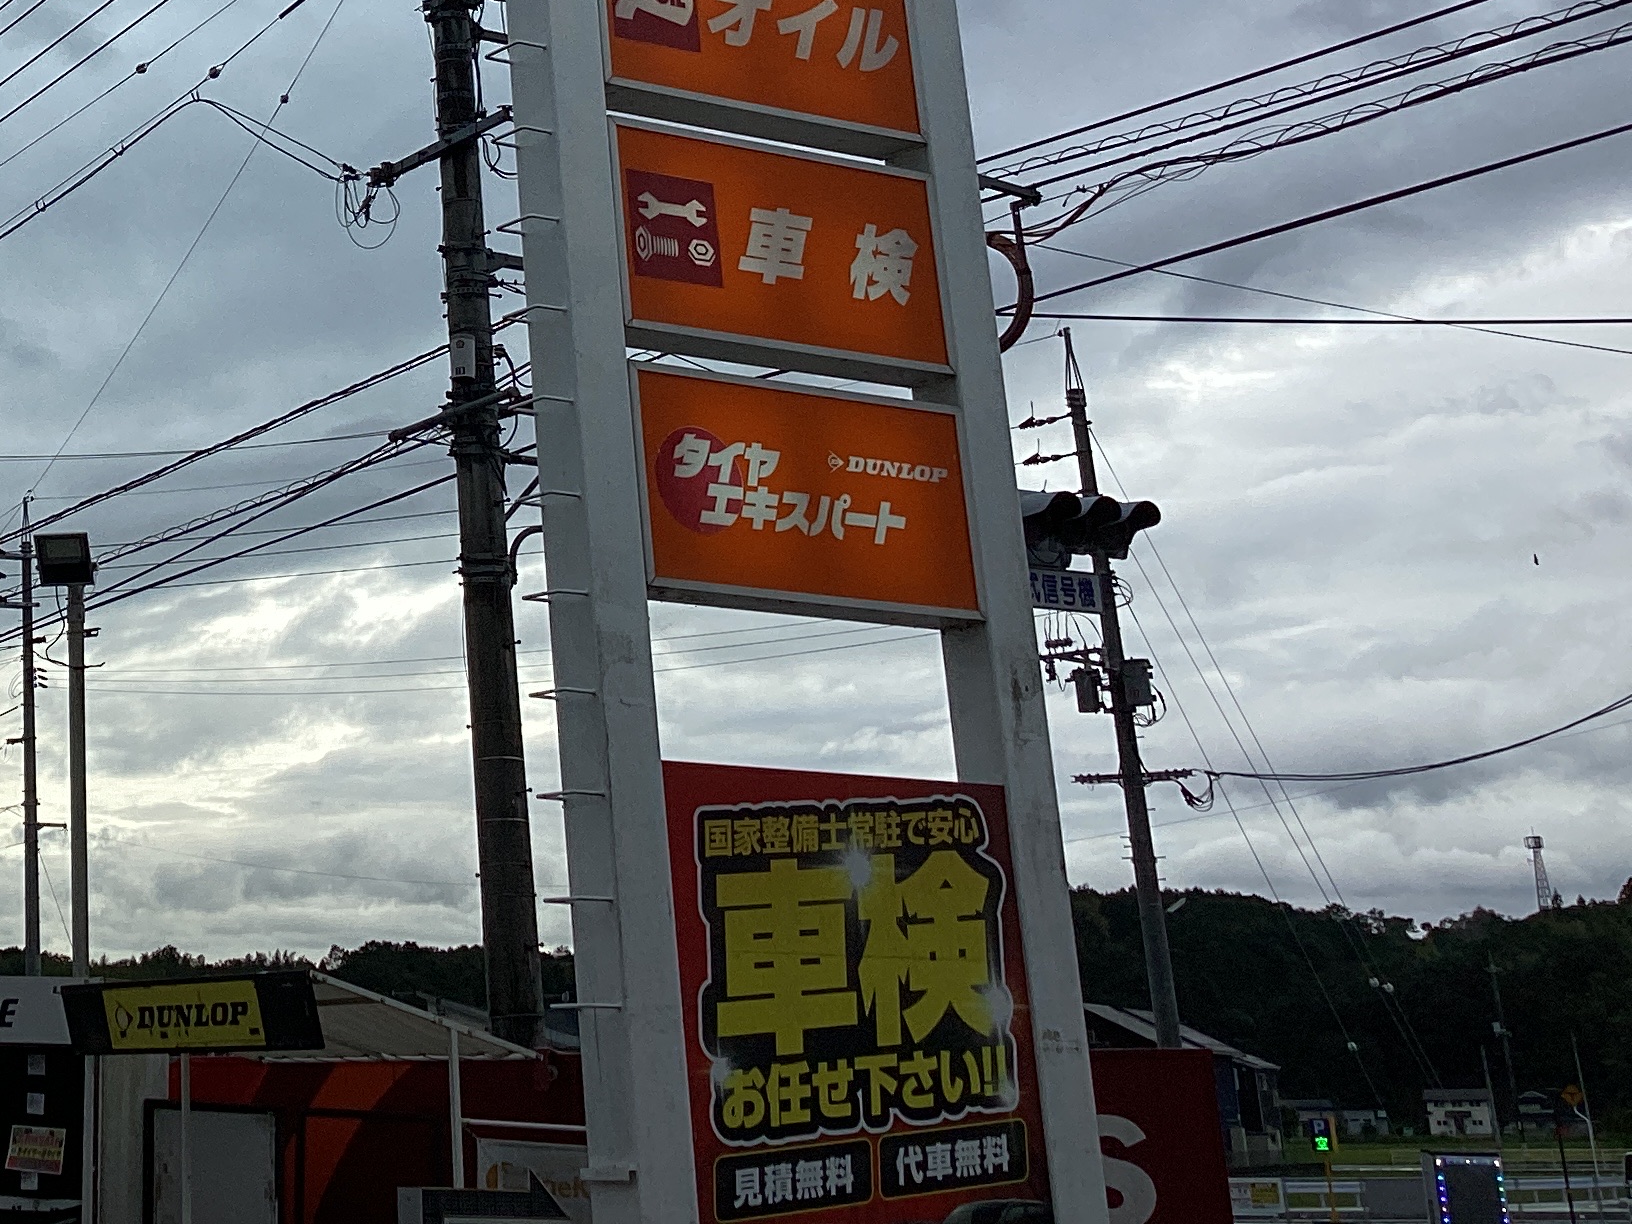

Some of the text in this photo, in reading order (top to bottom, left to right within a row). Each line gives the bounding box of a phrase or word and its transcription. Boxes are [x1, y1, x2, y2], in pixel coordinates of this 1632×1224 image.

[672, 432, 781, 487] タイヤ
[846, 455, 948, 483] DUNLOP
[699, 482, 907, 545] エキスパート
[704, 807, 980, 858] 国家整備士常駐で安心
[716, 850, 994, 1055] 車検
[137, 1001, 249, 1029] DUNLOP
[733, 1154, 854, 1210] 見積無料
[895, 1133, 1010, 1187] 代車無料
